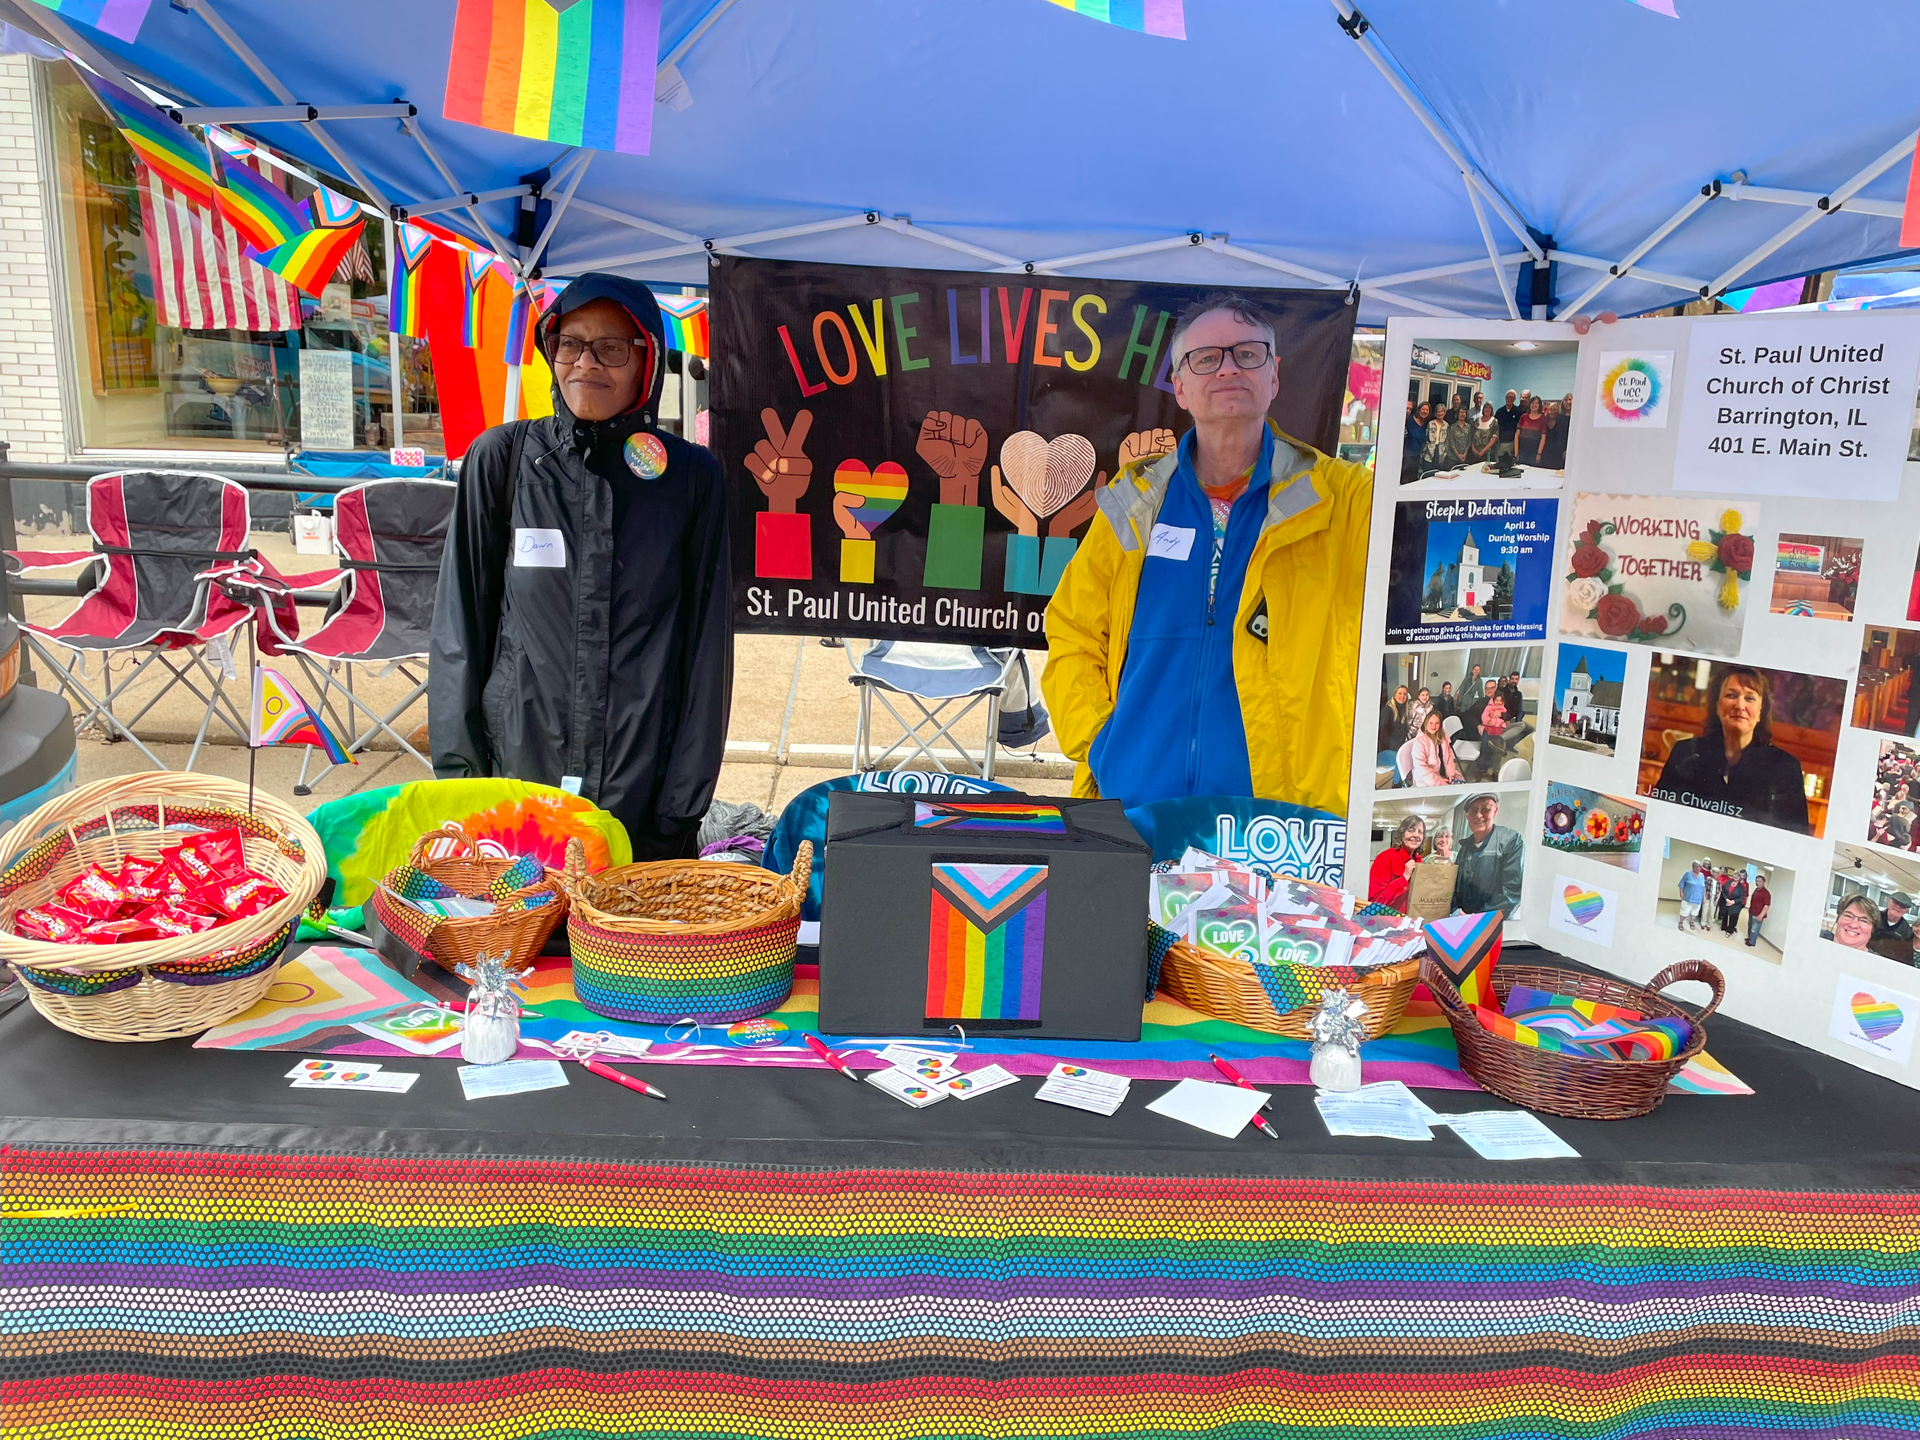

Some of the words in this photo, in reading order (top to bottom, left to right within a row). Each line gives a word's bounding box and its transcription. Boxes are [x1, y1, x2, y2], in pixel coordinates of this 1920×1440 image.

[777, 292, 930, 398] LOVE
[947, 286, 1108, 372] LIVES
[1719, 347, 1747, 365] St.
[1754, 345, 1803, 364] Paul
[1809, 343, 1885, 363] United
[1630, 376, 1647, 386] Paul
[1706, 377, 1784, 395] Church
[1791, 376, 1815, 394] of
[1820, 376, 1891, 395] Christ
[1623, 387, 1641, 398] UCC
[1717, 407, 1840, 429] Barrington,
[1847, 408, 1868, 426] IL
[643, 444, 657, 459] ARE
[648, 438, 662, 453] YOU
[1708, 436, 1744, 454] 401
[1751, 437, 1771, 455] E.
[1779, 438, 1831, 456] Main
[1838, 439, 1868, 458] St.
[1214, 507, 1228, 520] ARE
[1425, 499, 1465, 523] Steeple
[1468, 499, 1526, 518] Dedication!
[1504, 521, 1524, 531] April
[1525, 521, 1536, 530] 16
[1613, 515, 1701, 540] WORKING
[517, 535, 554, 553] Dawn
[1153, 531, 1180, 552] Andy
[1488, 534, 1515, 544] During
[1516, 533, 1550, 544] Worship
[1500, 546, 1518, 554] 9:30
[1618, 555, 1703, 582] TOGETHER
[746, 586, 779, 617] St.
[787, 588, 839, 620] Paul
[848, 592, 926, 625] United
[934, 596, 1018, 630] Church
[1403, 627, 1431, 636] together
[1440, 626, 1454, 635] give
[1470, 624, 1492, 632] thanks
[1516, 623, 1543, 631] blessing
[1406, 634, 1413, 642] of
[1475, 631, 1491, 639] huge
[1492, 630, 1526, 638] endeavor!
[1643, 784, 1677, 801] Jana
[1680, 791, 1744, 817] Chwalisz
[1216, 814, 1346, 867] LOVE
[81, 874, 118, 902] Skittles
[1213, 929, 1245, 944] LOVE
[1274, 947, 1310, 965] LOVE
[400, 1012, 440, 1028] LOVE
